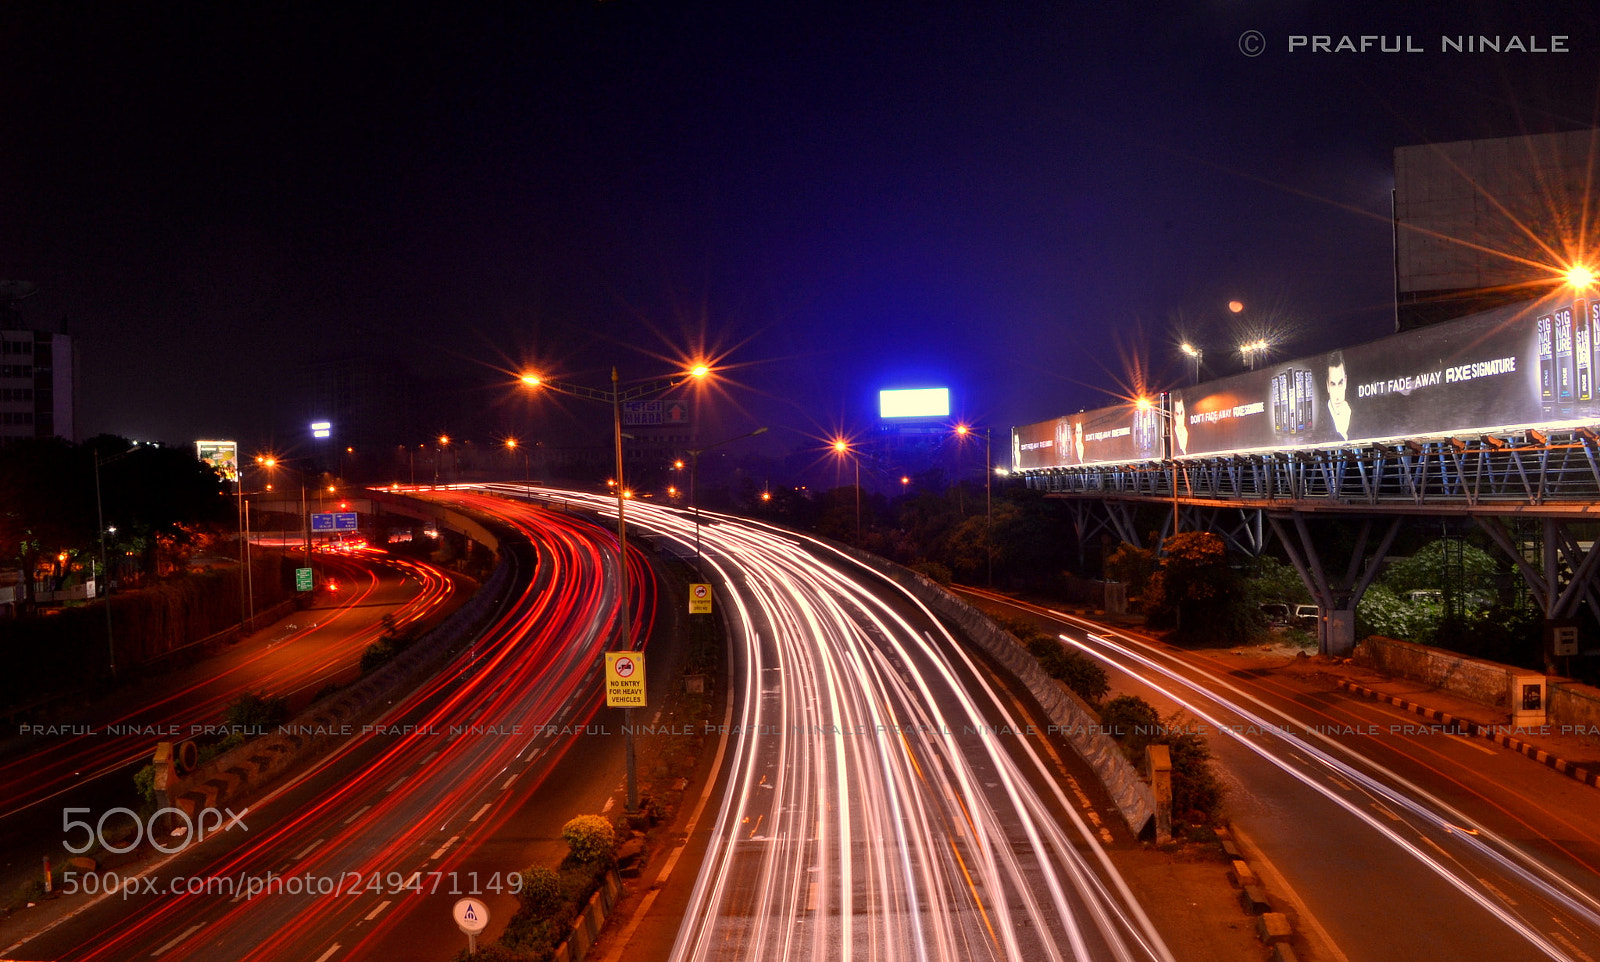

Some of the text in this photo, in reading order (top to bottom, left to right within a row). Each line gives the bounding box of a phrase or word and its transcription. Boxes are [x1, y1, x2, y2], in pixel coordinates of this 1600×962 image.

[1555, 310, 1571, 327] SIG
[1556, 324, 1571, 341] NAT
[1557, 337, 1572, 353] URE
[1358, 356, 1516, 398] DON'T FADE AWAY AXE SIGNATURE
